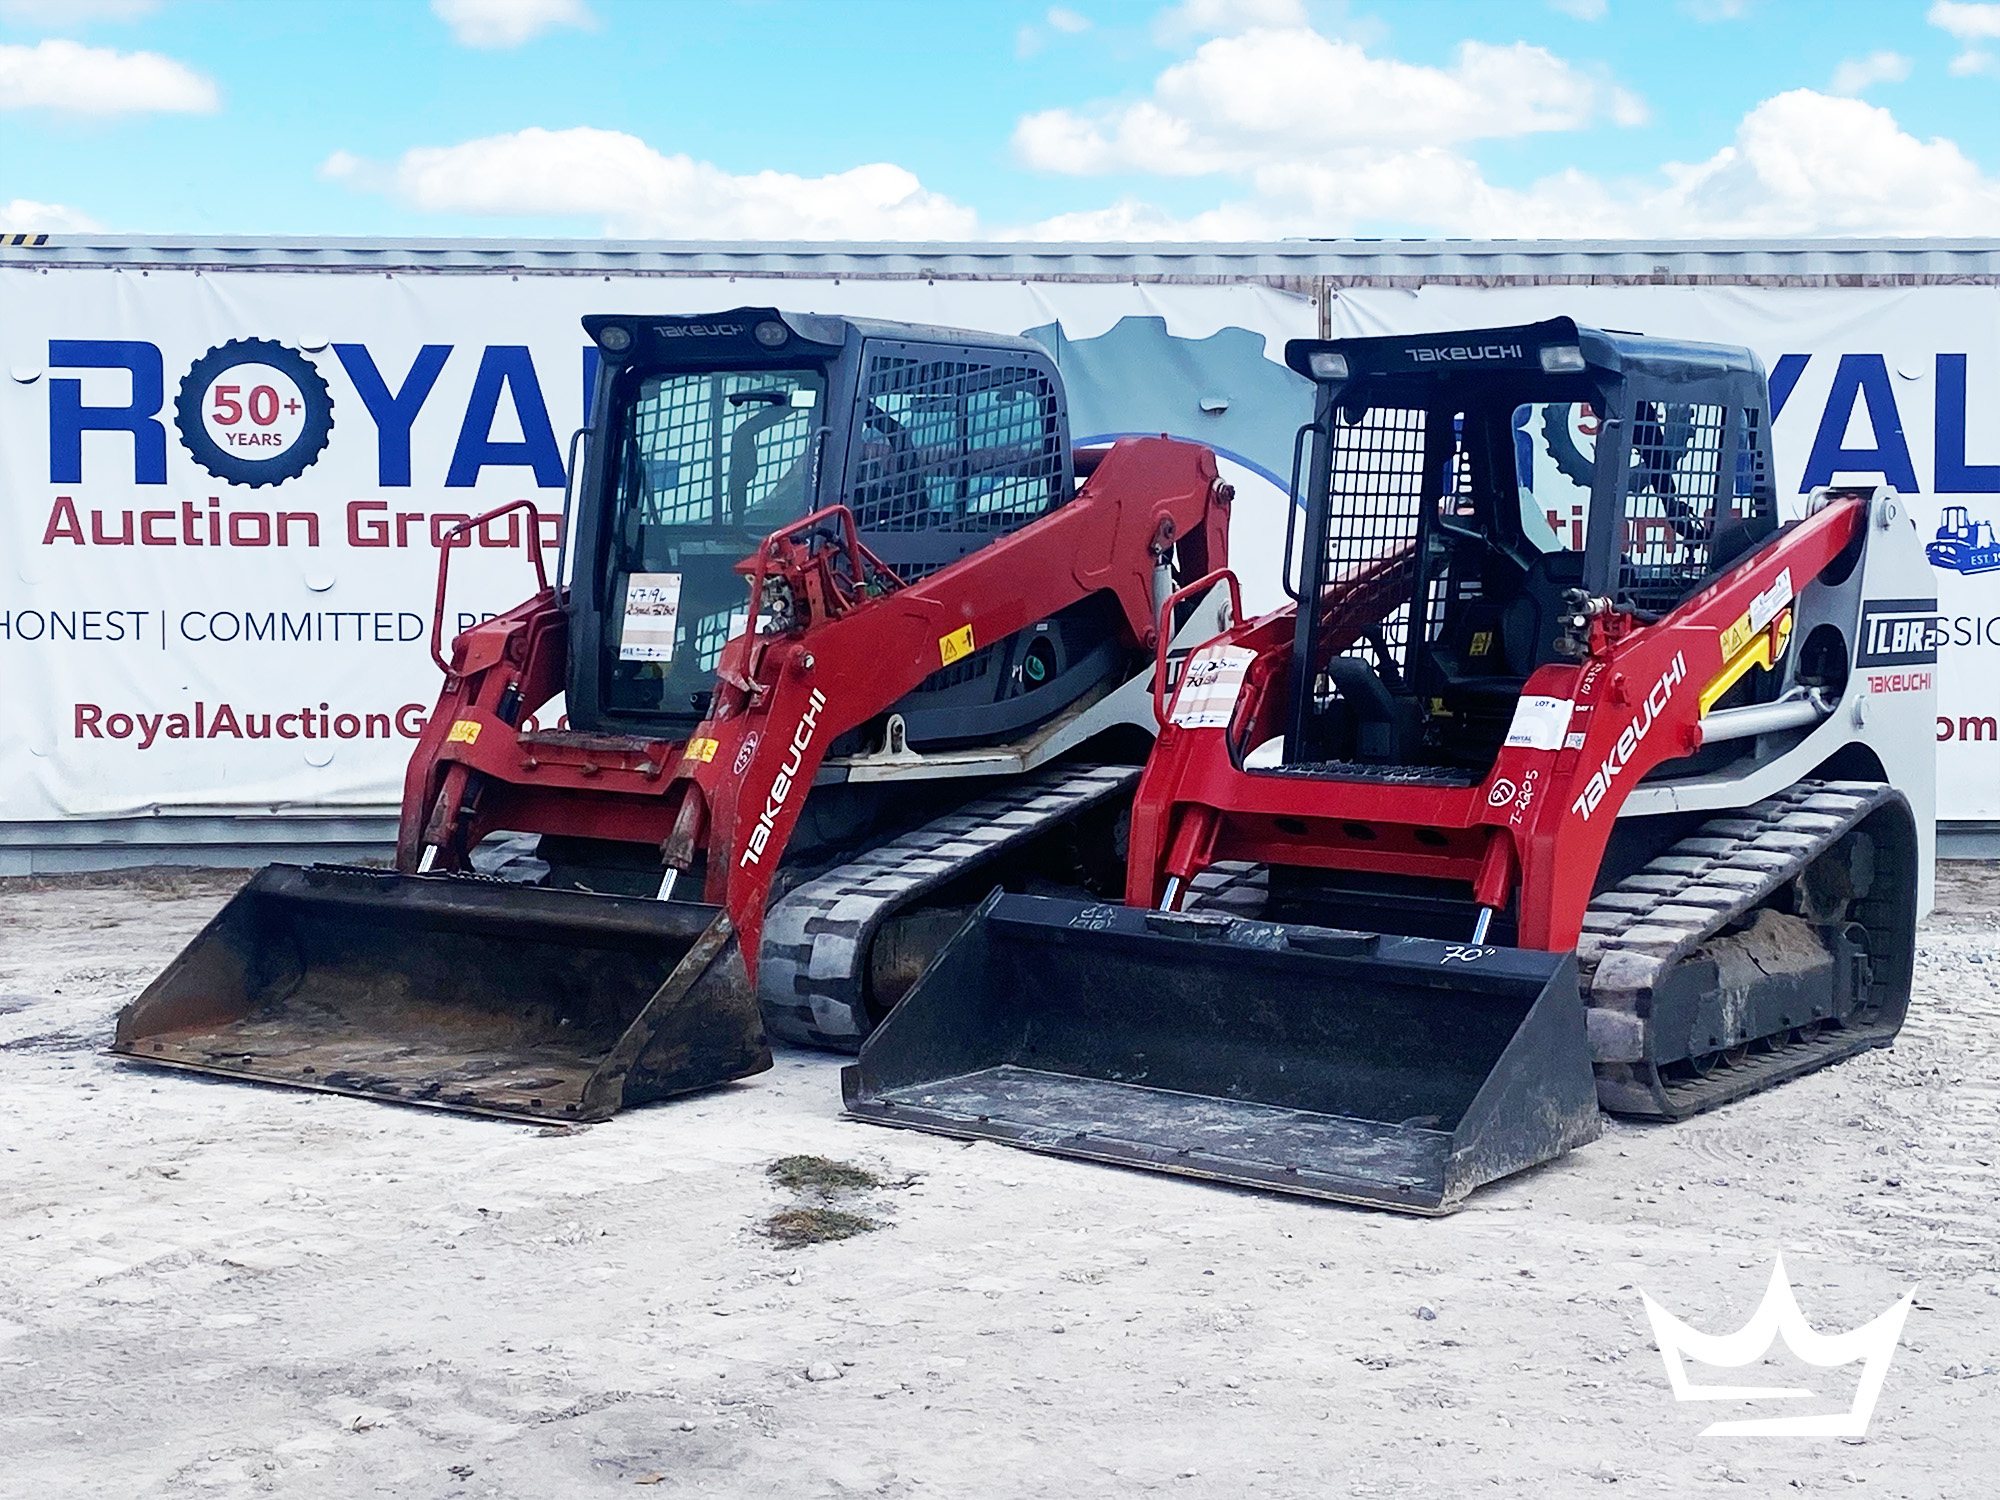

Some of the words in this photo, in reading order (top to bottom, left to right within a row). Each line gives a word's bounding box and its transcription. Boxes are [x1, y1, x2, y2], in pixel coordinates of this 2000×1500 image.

[1405, 344, 1523, 362] TAKEUCHI
[48, 336, 600, 490] ROYA
[211, 384, 302, 426] 50+
[226, 432, 282, 447] YEARS
[42, 496, 320, 547] Auction
[347, 500, 563, 562] Group
[180, 611, 425, 643] COMMITTED
[1867, 673, 1932, 694] TAKEUCHI
[1571, 649, 1688, 822] TAKEUCHI
[739, 687, 827, 868] TAKEUCHI
